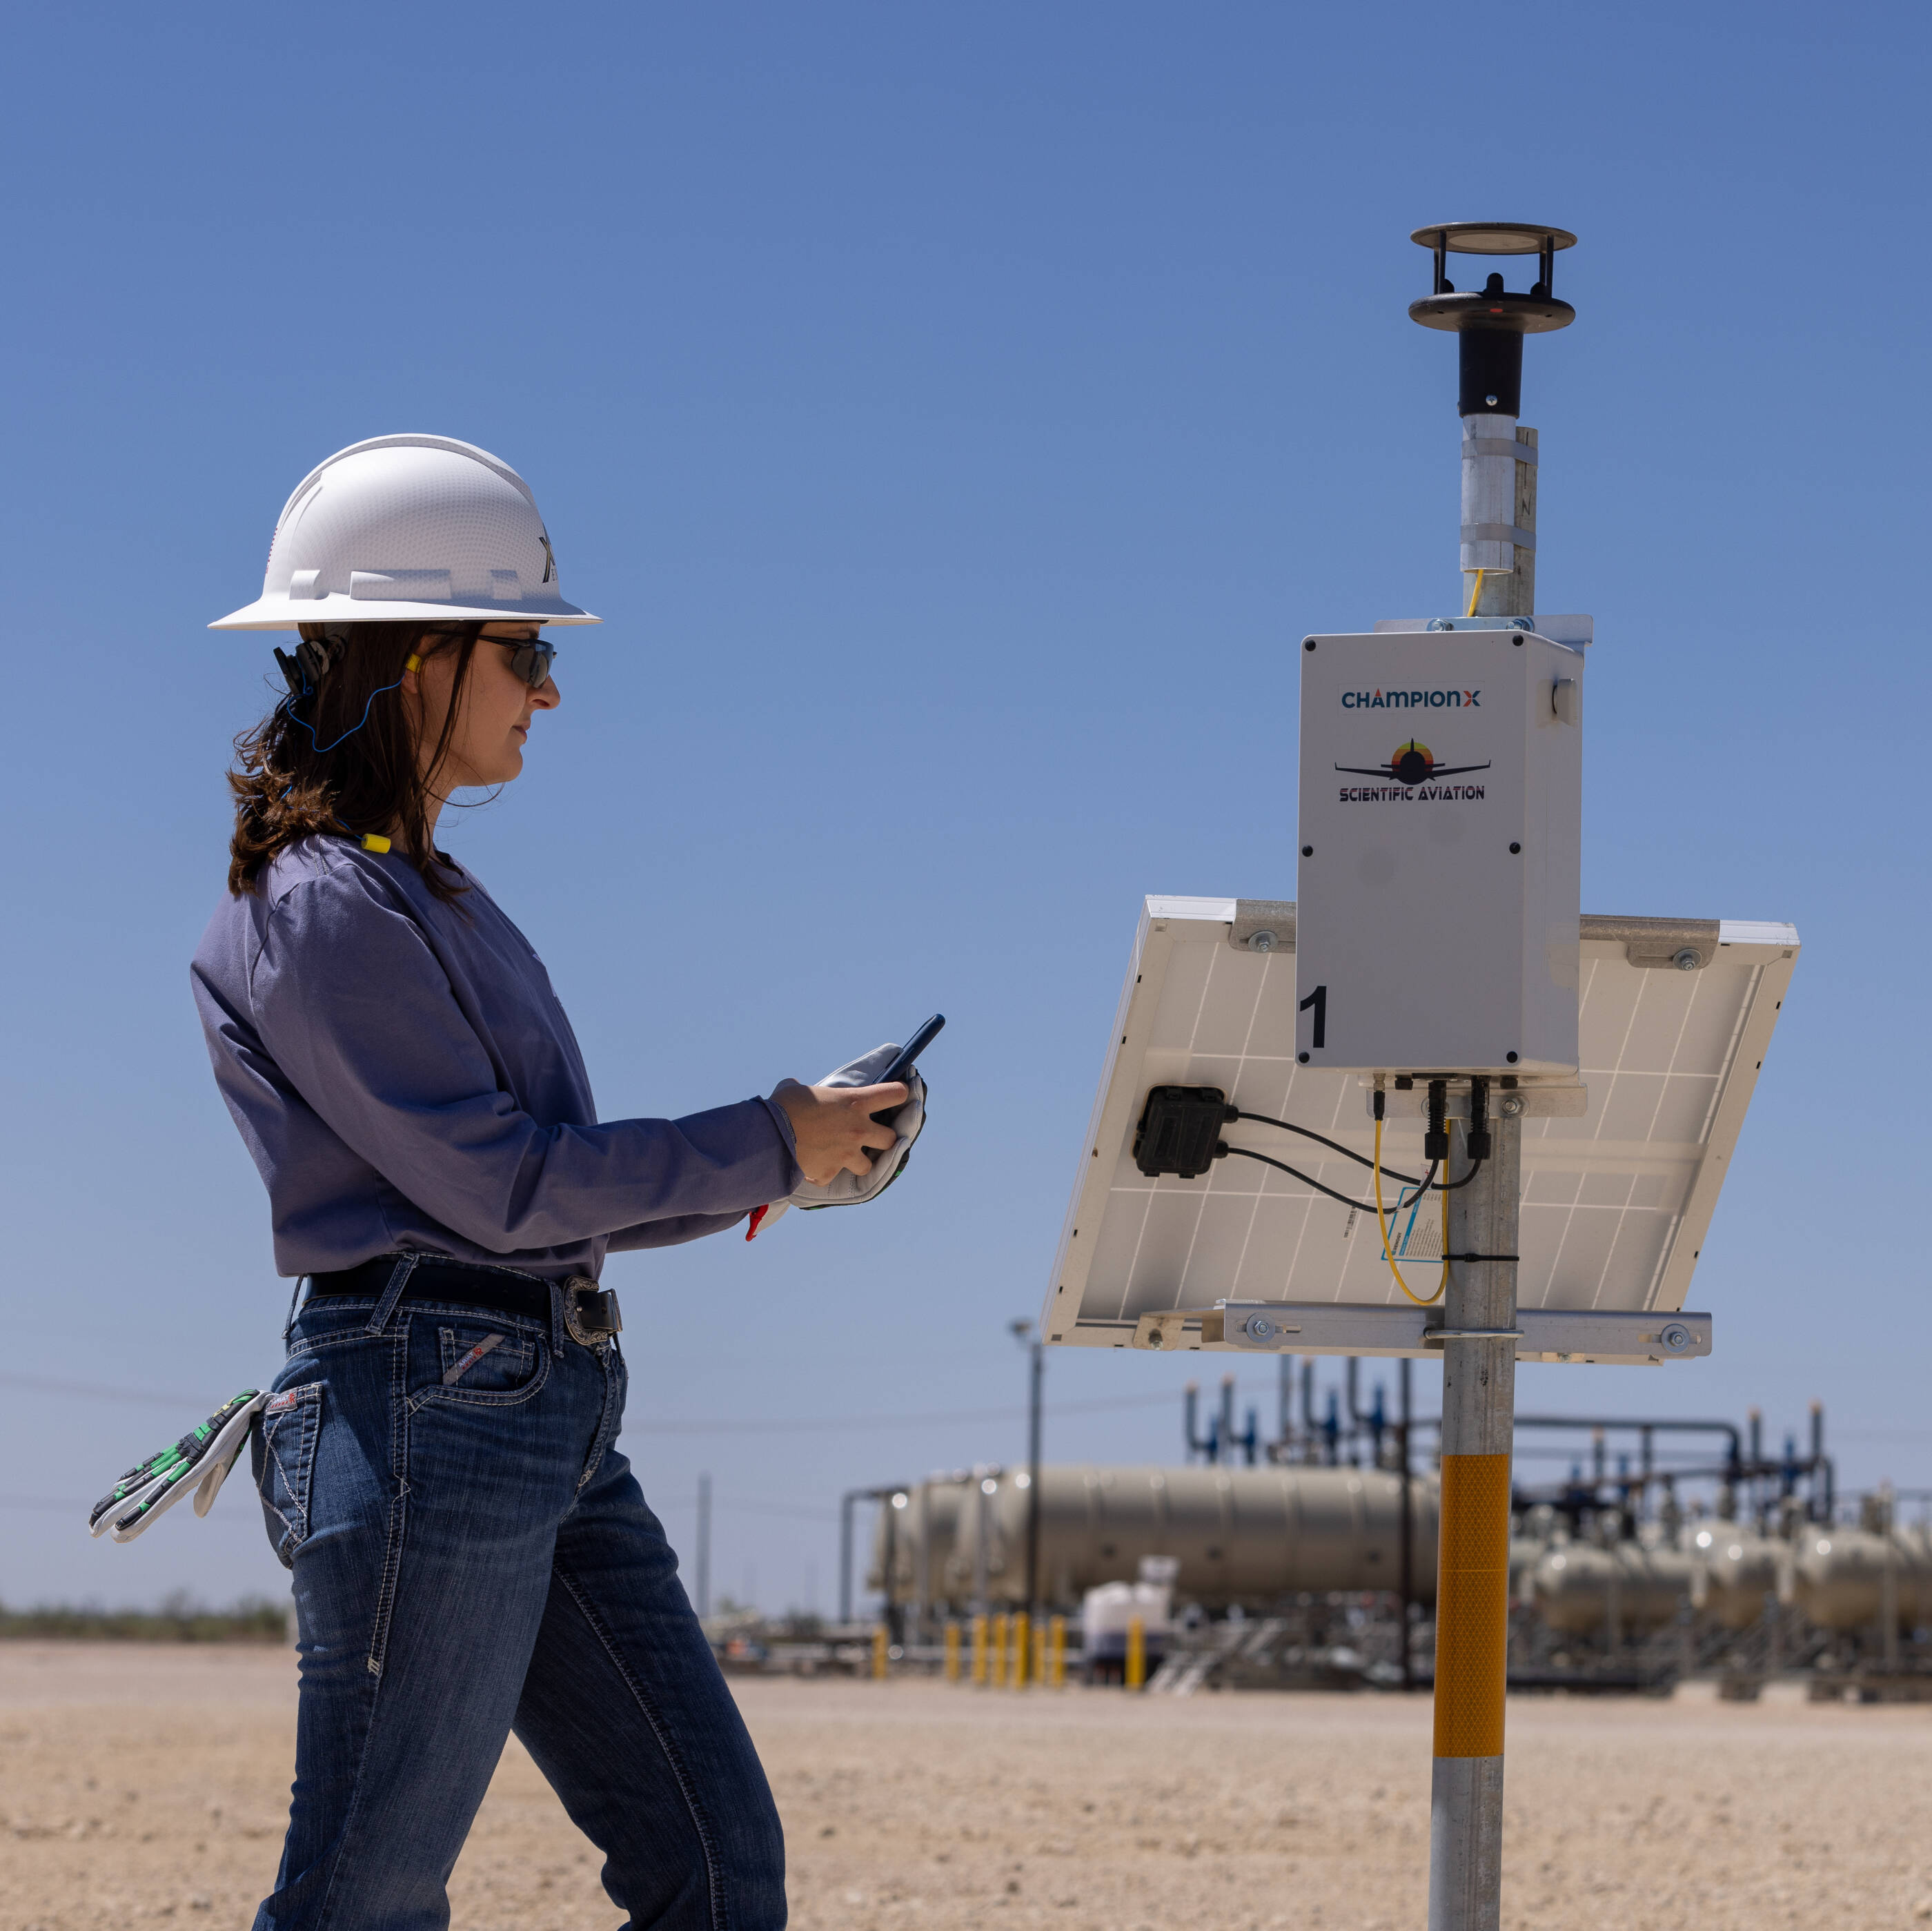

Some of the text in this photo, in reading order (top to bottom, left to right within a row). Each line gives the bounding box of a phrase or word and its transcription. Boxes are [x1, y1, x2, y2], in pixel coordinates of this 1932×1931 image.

[1339, 785, 1485, 802] SCIENTIFIC AVIATION
[1299, 985, 1327, 1048] 1
[458, 1351, 474, 1369] ARIAT
